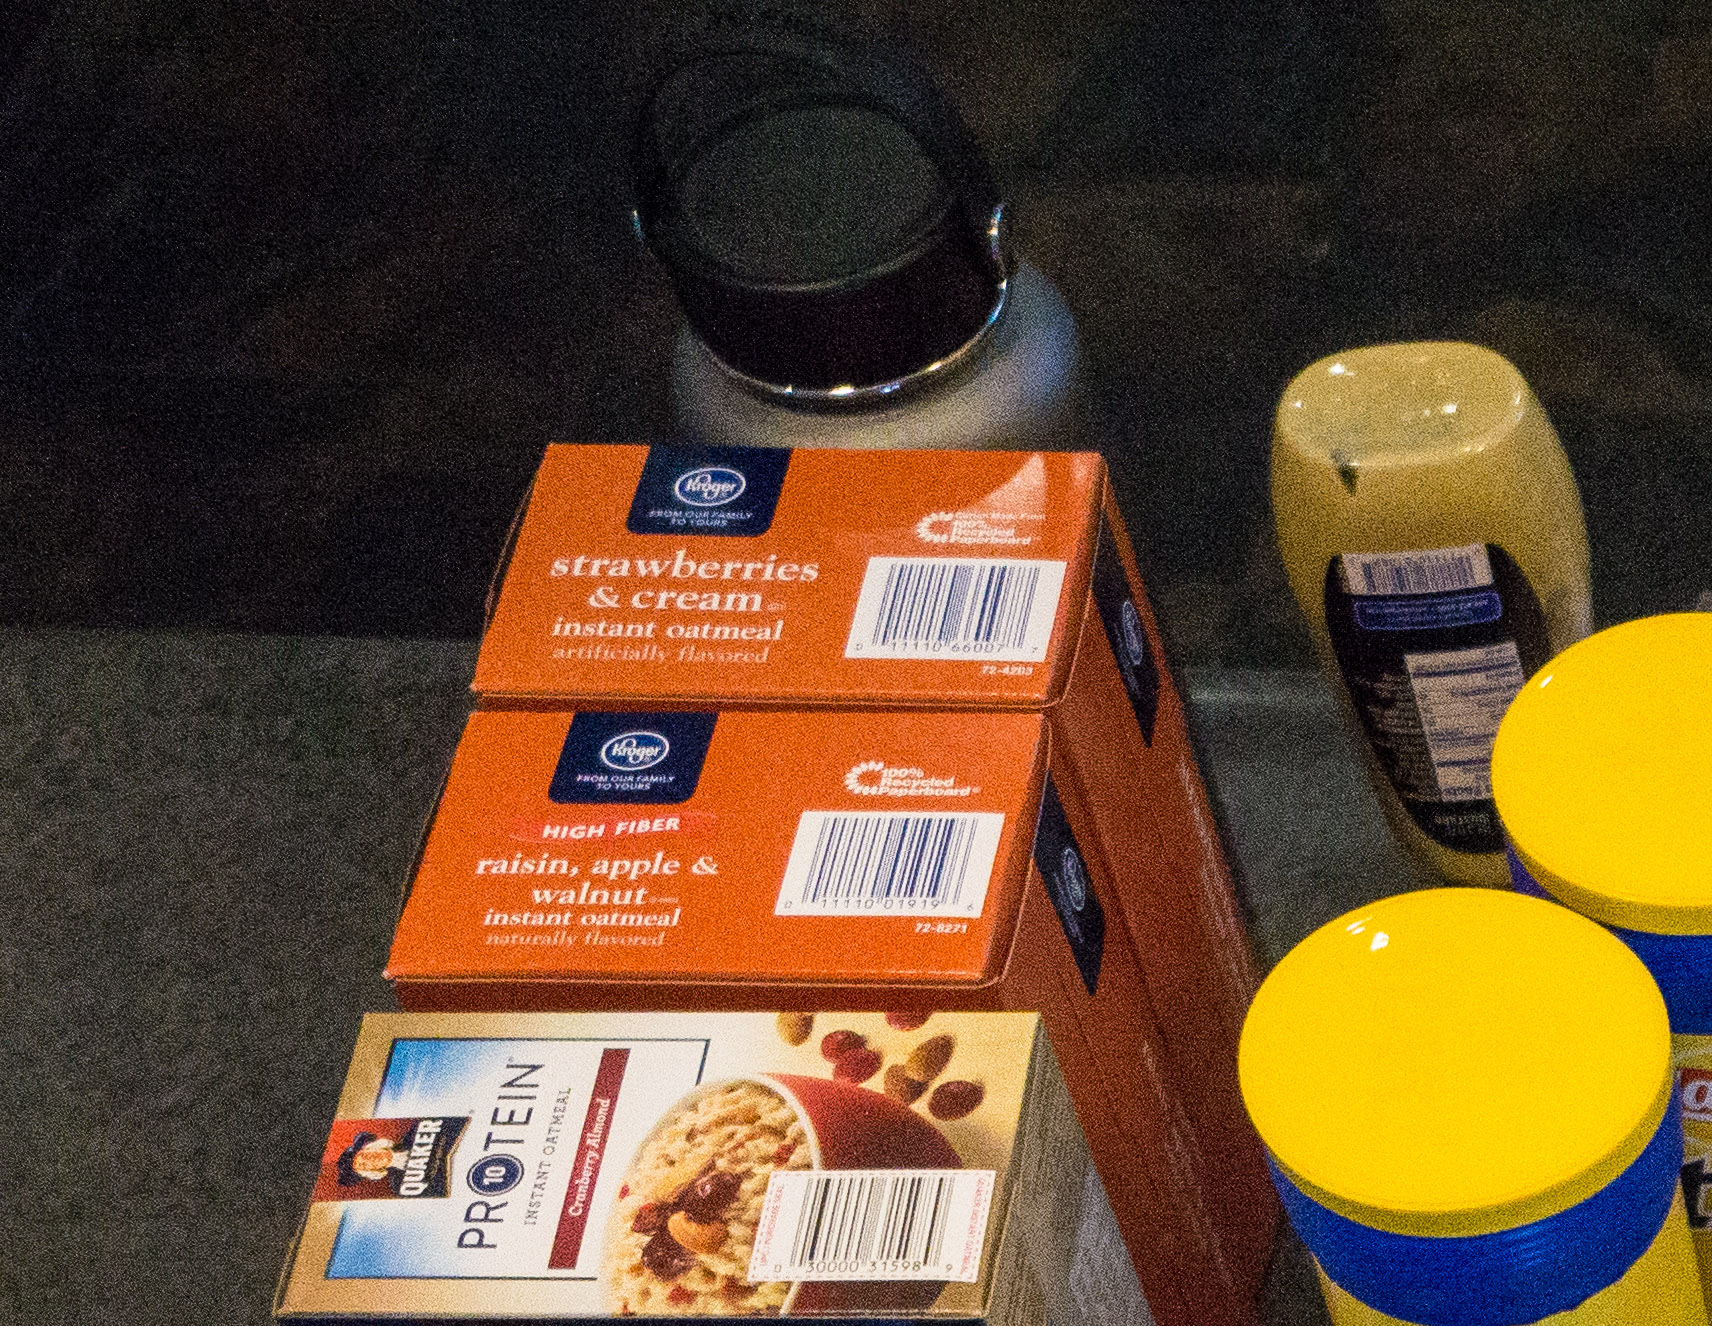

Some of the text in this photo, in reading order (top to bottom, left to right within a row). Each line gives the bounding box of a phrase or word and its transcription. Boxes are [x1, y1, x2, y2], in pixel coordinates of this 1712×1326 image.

[685, 473, 738, 500] Kroger
[550, 548, 820, 583] strawberries
[587, 585, 763, 612] & cream
[552, 616, 785, 642] instant oatmeal
[552, 644, 770, 664] artificially flavored
[611, 736, 663, 765] Kroger
[575, 773, 676, 784] FROM OUR FAMILY
[880, 775, 956, 789] Recycled
[881, 766, 925, 779] 100%
[614, 782, 652, 791] YOURS
[878, 785, 972, 798] Paperboard
[541, 816, 681, 840] HIGH FIBER
[474, 850, 720, 881] raisin, apple &
[531, 880, 650, 906] walnut
[482, 907, 682, 928] instant oatmeal
[485, 930, 667, 948] naturally flavored
[399, 1117, 445, 1199] QUAKER
[523, 1087, 573, 1227] INSTANT OATMEAL
[566, 1098, 613, 1217] Cranberry Almond
[804, 1260, 923, 1274] 30000 31598
